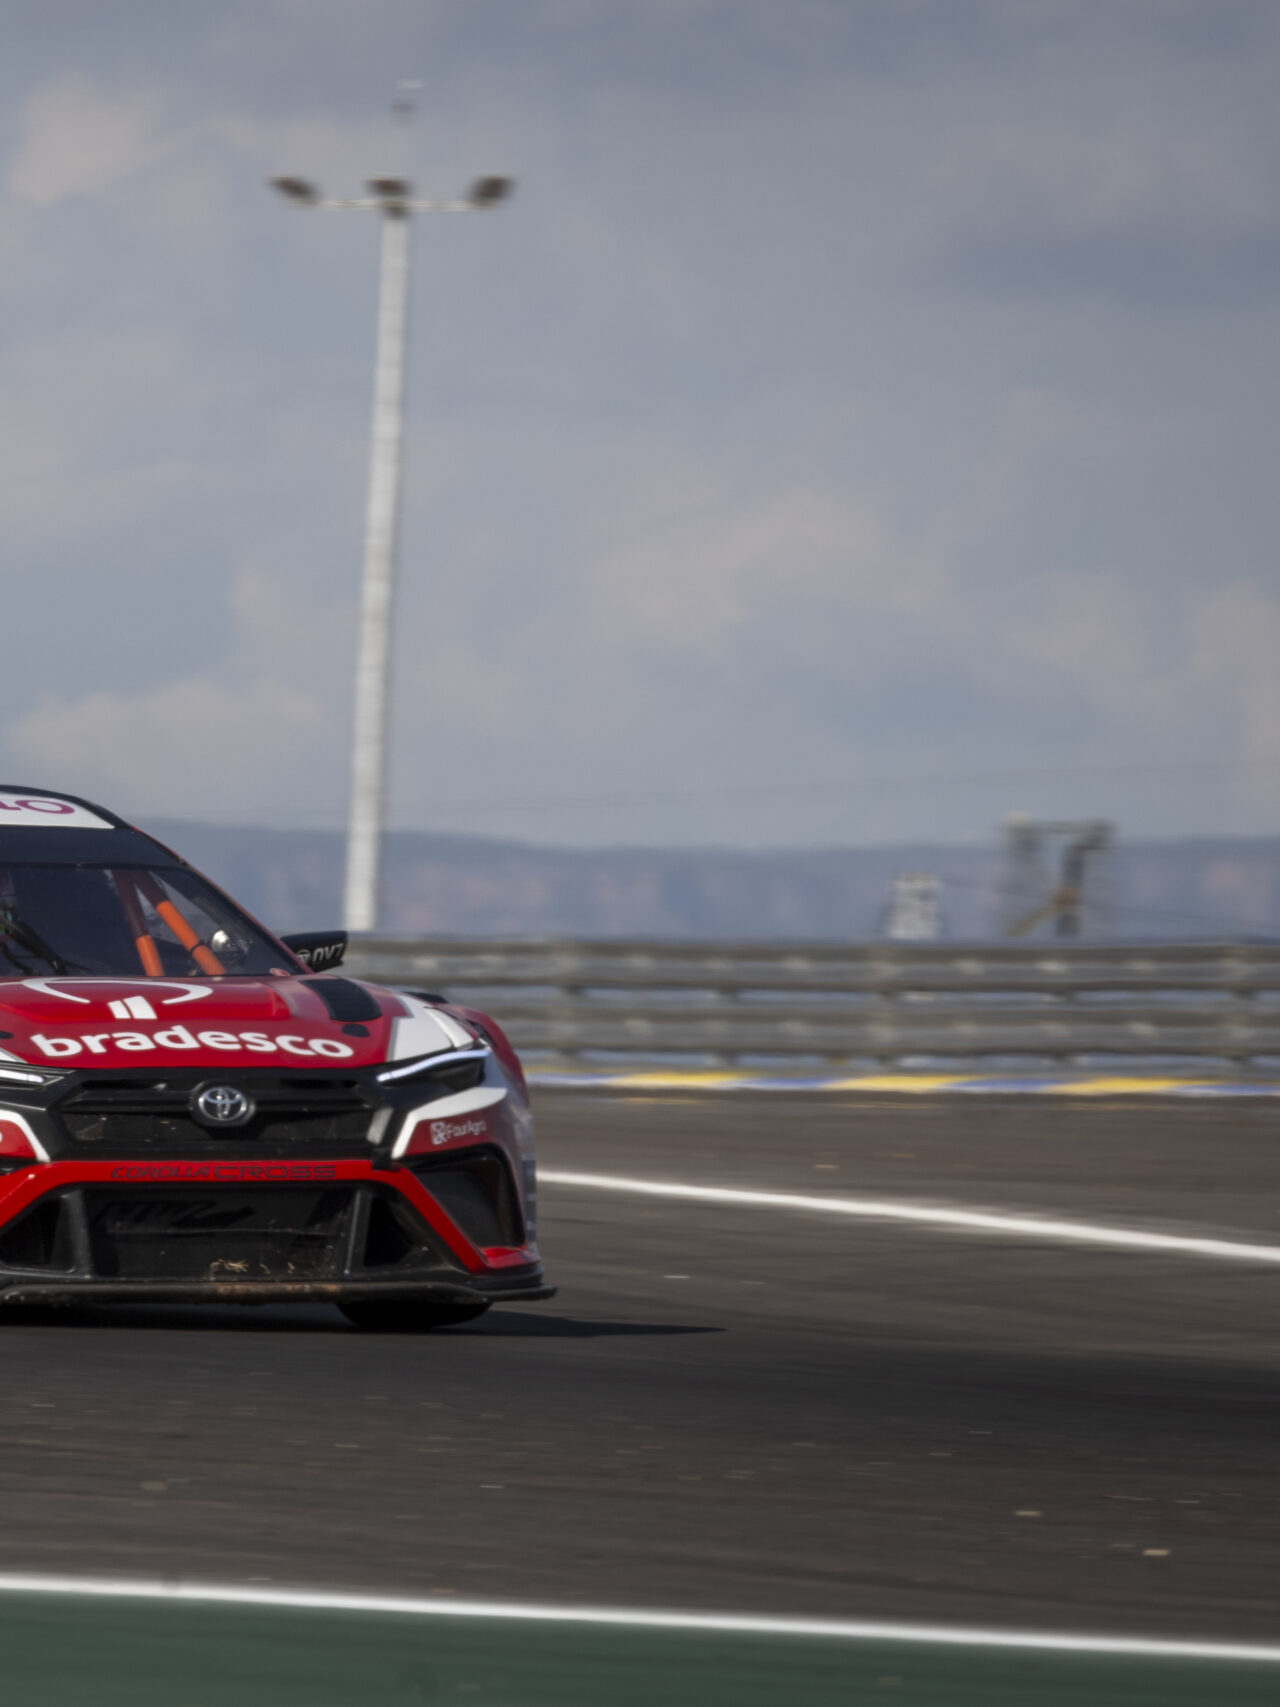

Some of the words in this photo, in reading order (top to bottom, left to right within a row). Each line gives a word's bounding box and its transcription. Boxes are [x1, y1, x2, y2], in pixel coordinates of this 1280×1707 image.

[30, 1025, 354, 1058] bradesco
[110, 1166, 210, 1179] COROLLA
[214, 1165, 336, 1179] CROSS
